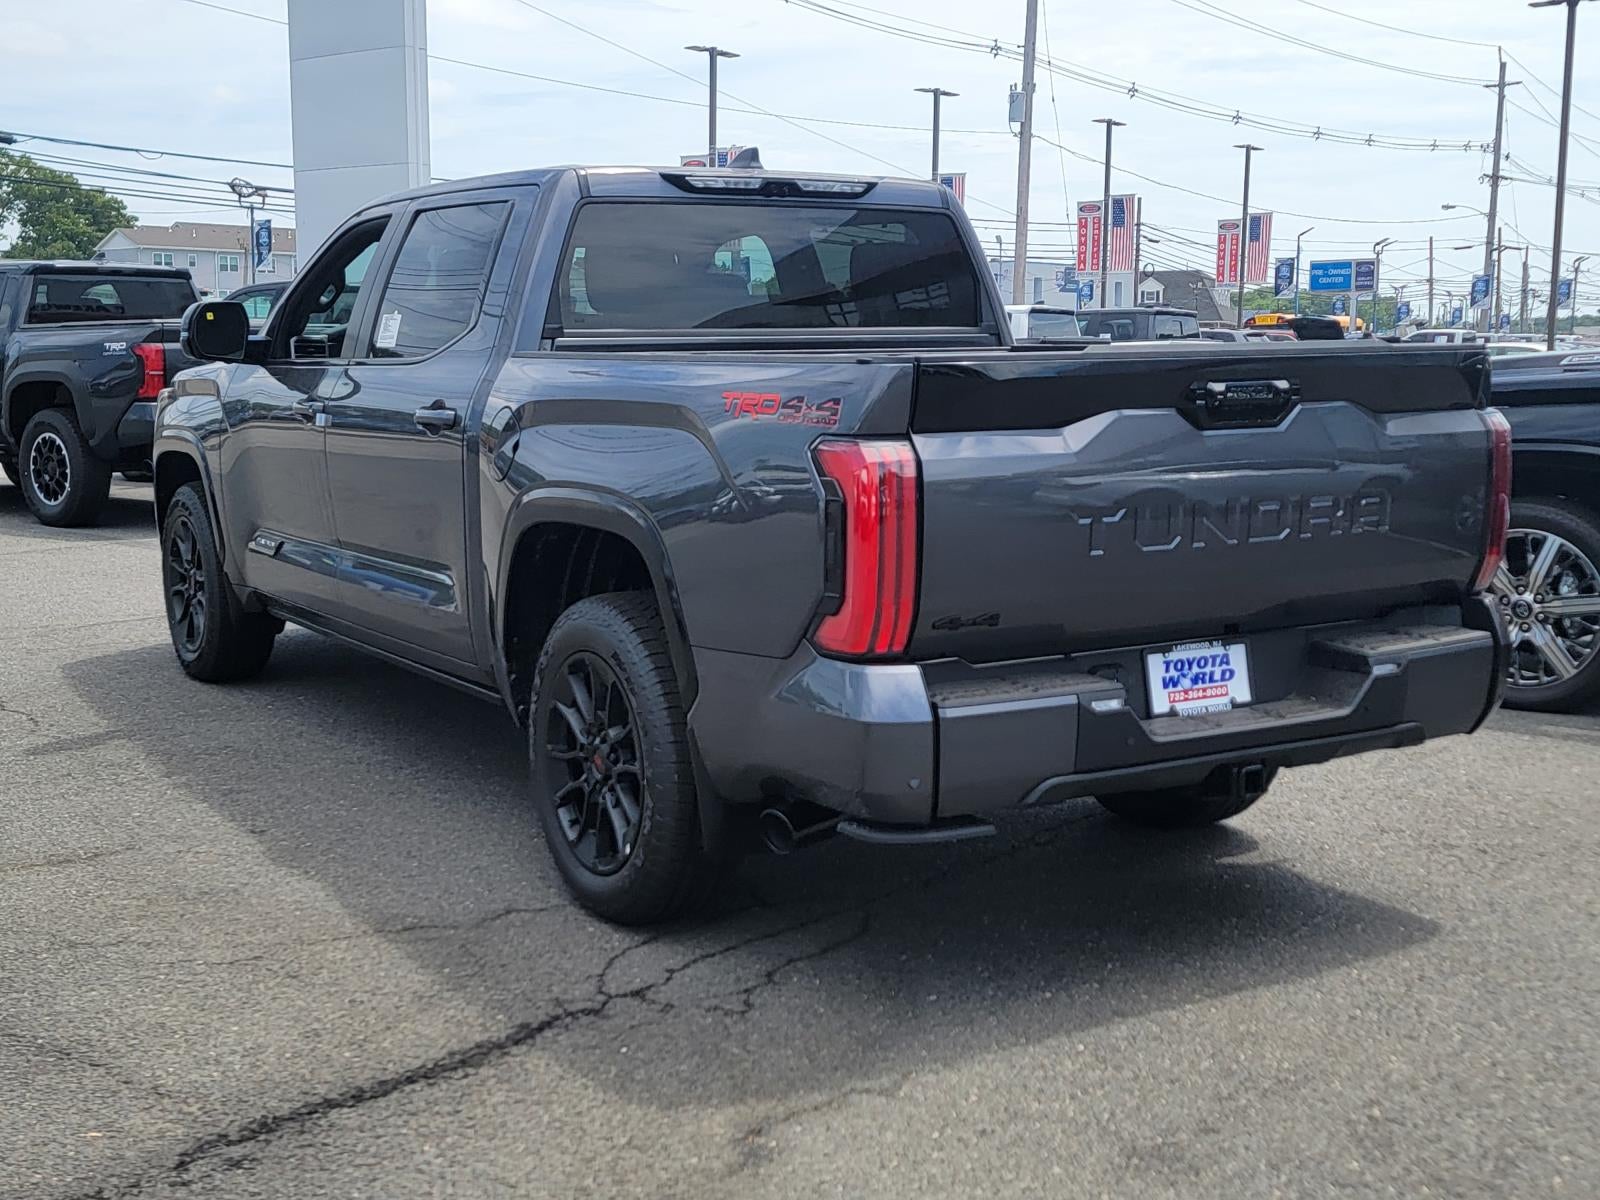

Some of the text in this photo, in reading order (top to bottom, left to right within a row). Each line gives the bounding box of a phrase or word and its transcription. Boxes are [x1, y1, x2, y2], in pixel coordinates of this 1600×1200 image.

[1078, 218, 1087, 270] TOYOTA
[1092, 217, 1100, 270] CERTIFIED
[1230, 234, 1238, 281] CERTIFIED
[1318, 276, 1344, 284] CENTER
[103, 342, 127, 351] TRD
[721, 390, 782, 421] TRD
[1069, 488, 1392, 557] TUNDRA
[1162, 652, 1231, 674] TOYOTA
[1179, 706, 1207, 717] TOYOTA
